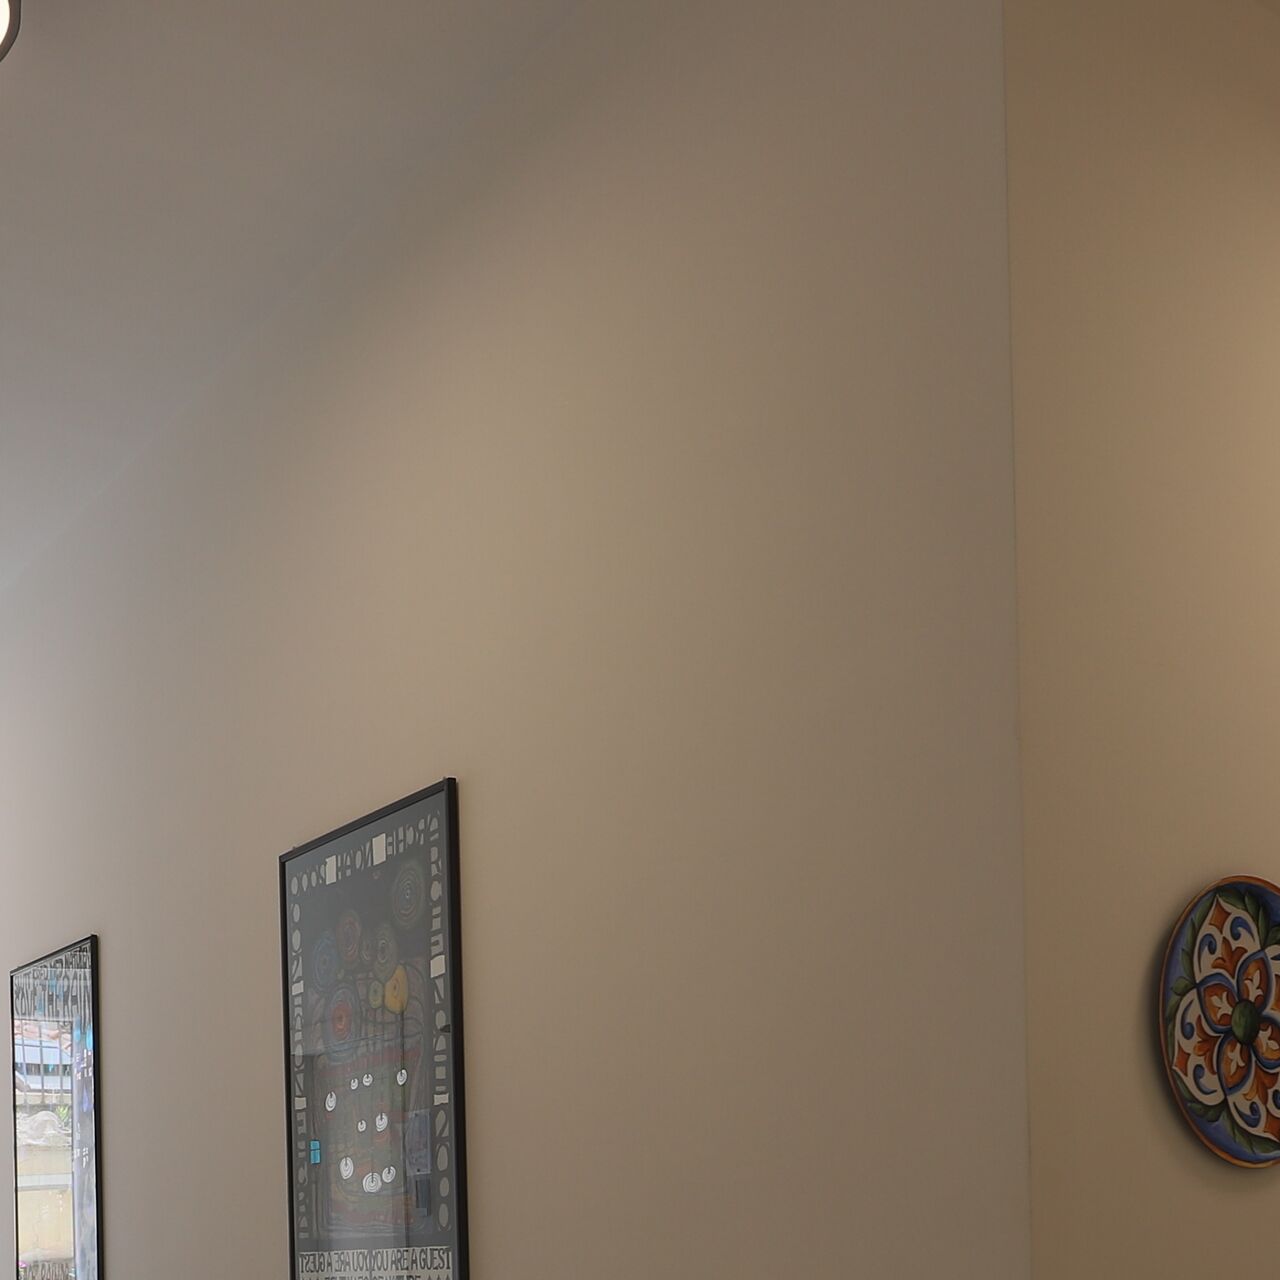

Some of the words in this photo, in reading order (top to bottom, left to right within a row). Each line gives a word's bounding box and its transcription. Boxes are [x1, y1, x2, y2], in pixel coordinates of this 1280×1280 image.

[63, 971, 92, 1030] RAIN
[372, 1250, 389, 1271] YOU
[391, 1249, 409, 1271] ARE
[411, 1249, 418, 1270] A
[419, 1247, 451, 1270] GUEST
